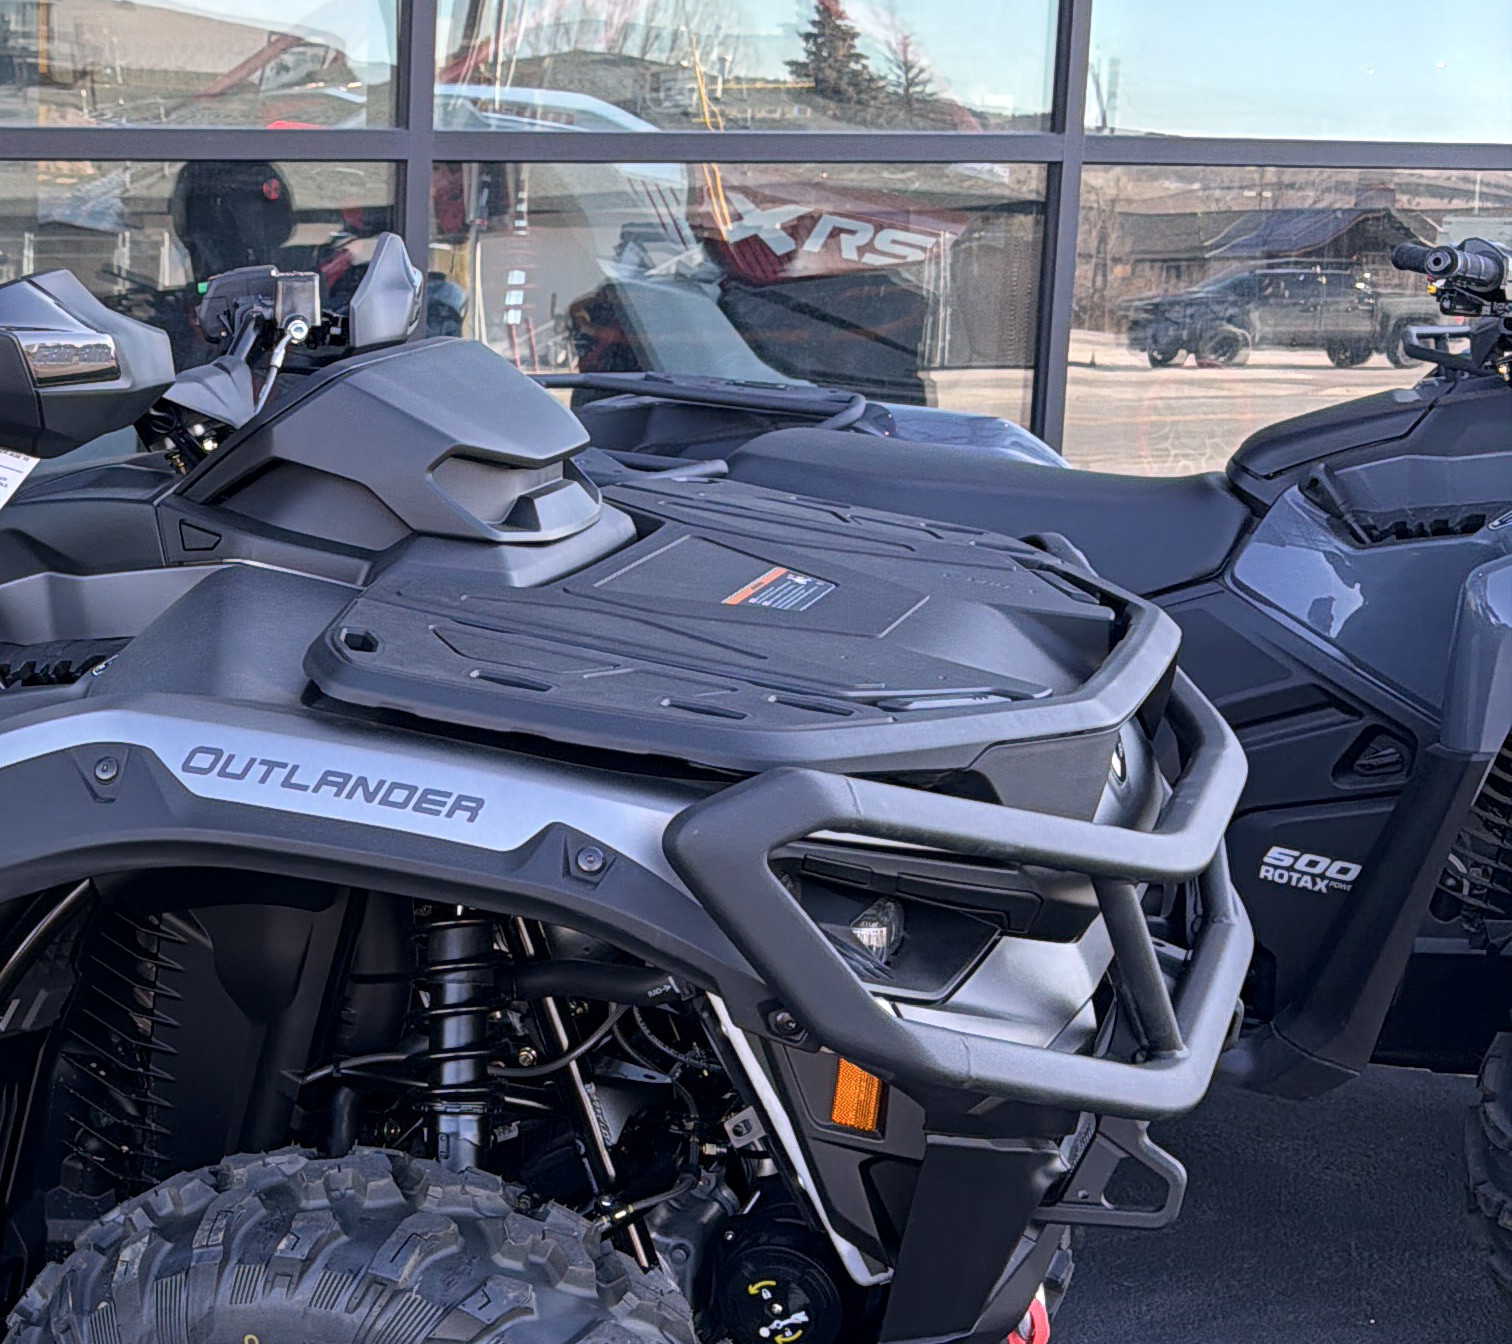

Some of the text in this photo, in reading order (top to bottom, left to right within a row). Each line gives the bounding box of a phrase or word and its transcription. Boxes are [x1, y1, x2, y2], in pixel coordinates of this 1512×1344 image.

[181, 745, 486, 823] OUTLANDER
[1259, 865, 1330, 894] ROTAX
[1263, 845, 1363, 882] 500
